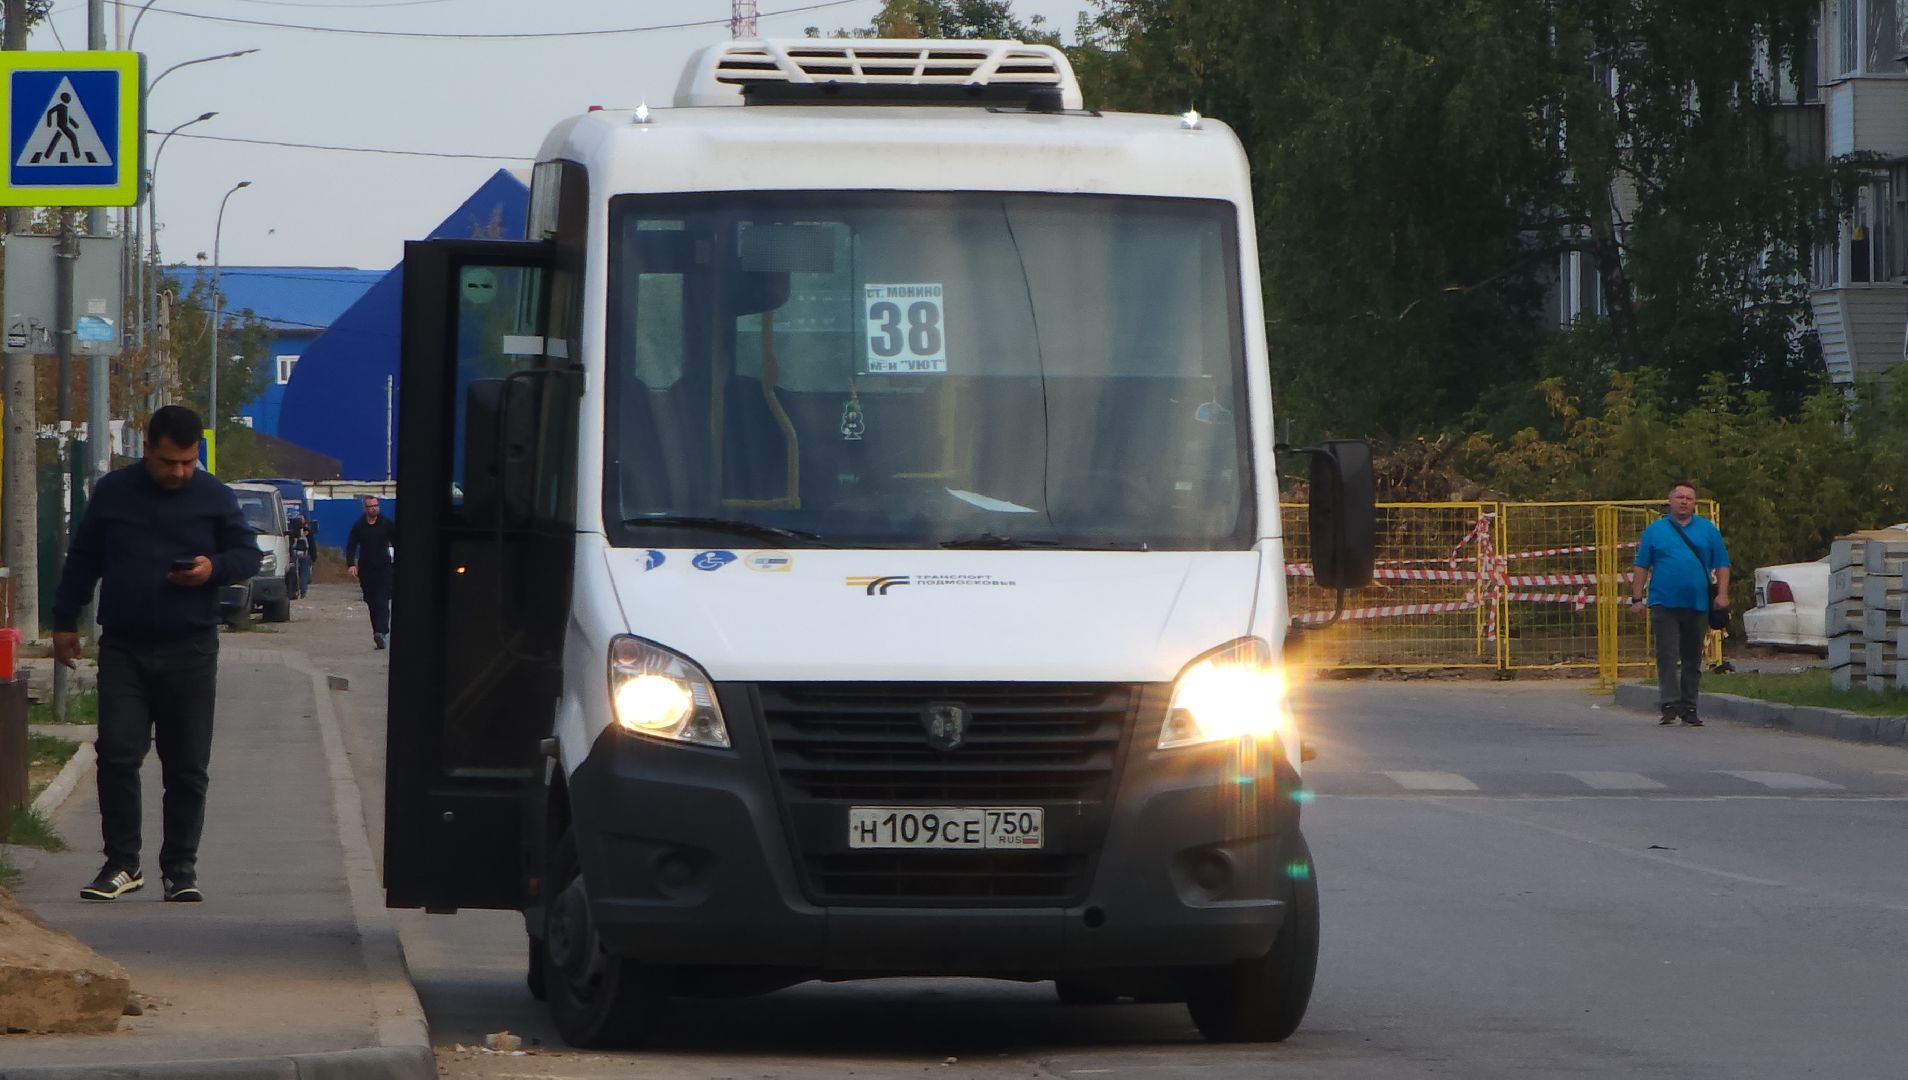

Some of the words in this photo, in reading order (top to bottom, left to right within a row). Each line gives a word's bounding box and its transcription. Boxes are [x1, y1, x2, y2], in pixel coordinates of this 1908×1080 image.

[887, 286, 941, 298] МОНИНО
[869, 301, 942, 357] 38
[987, 812, 1033, 835] 750
[999, 835, 1021, 844] RUS
